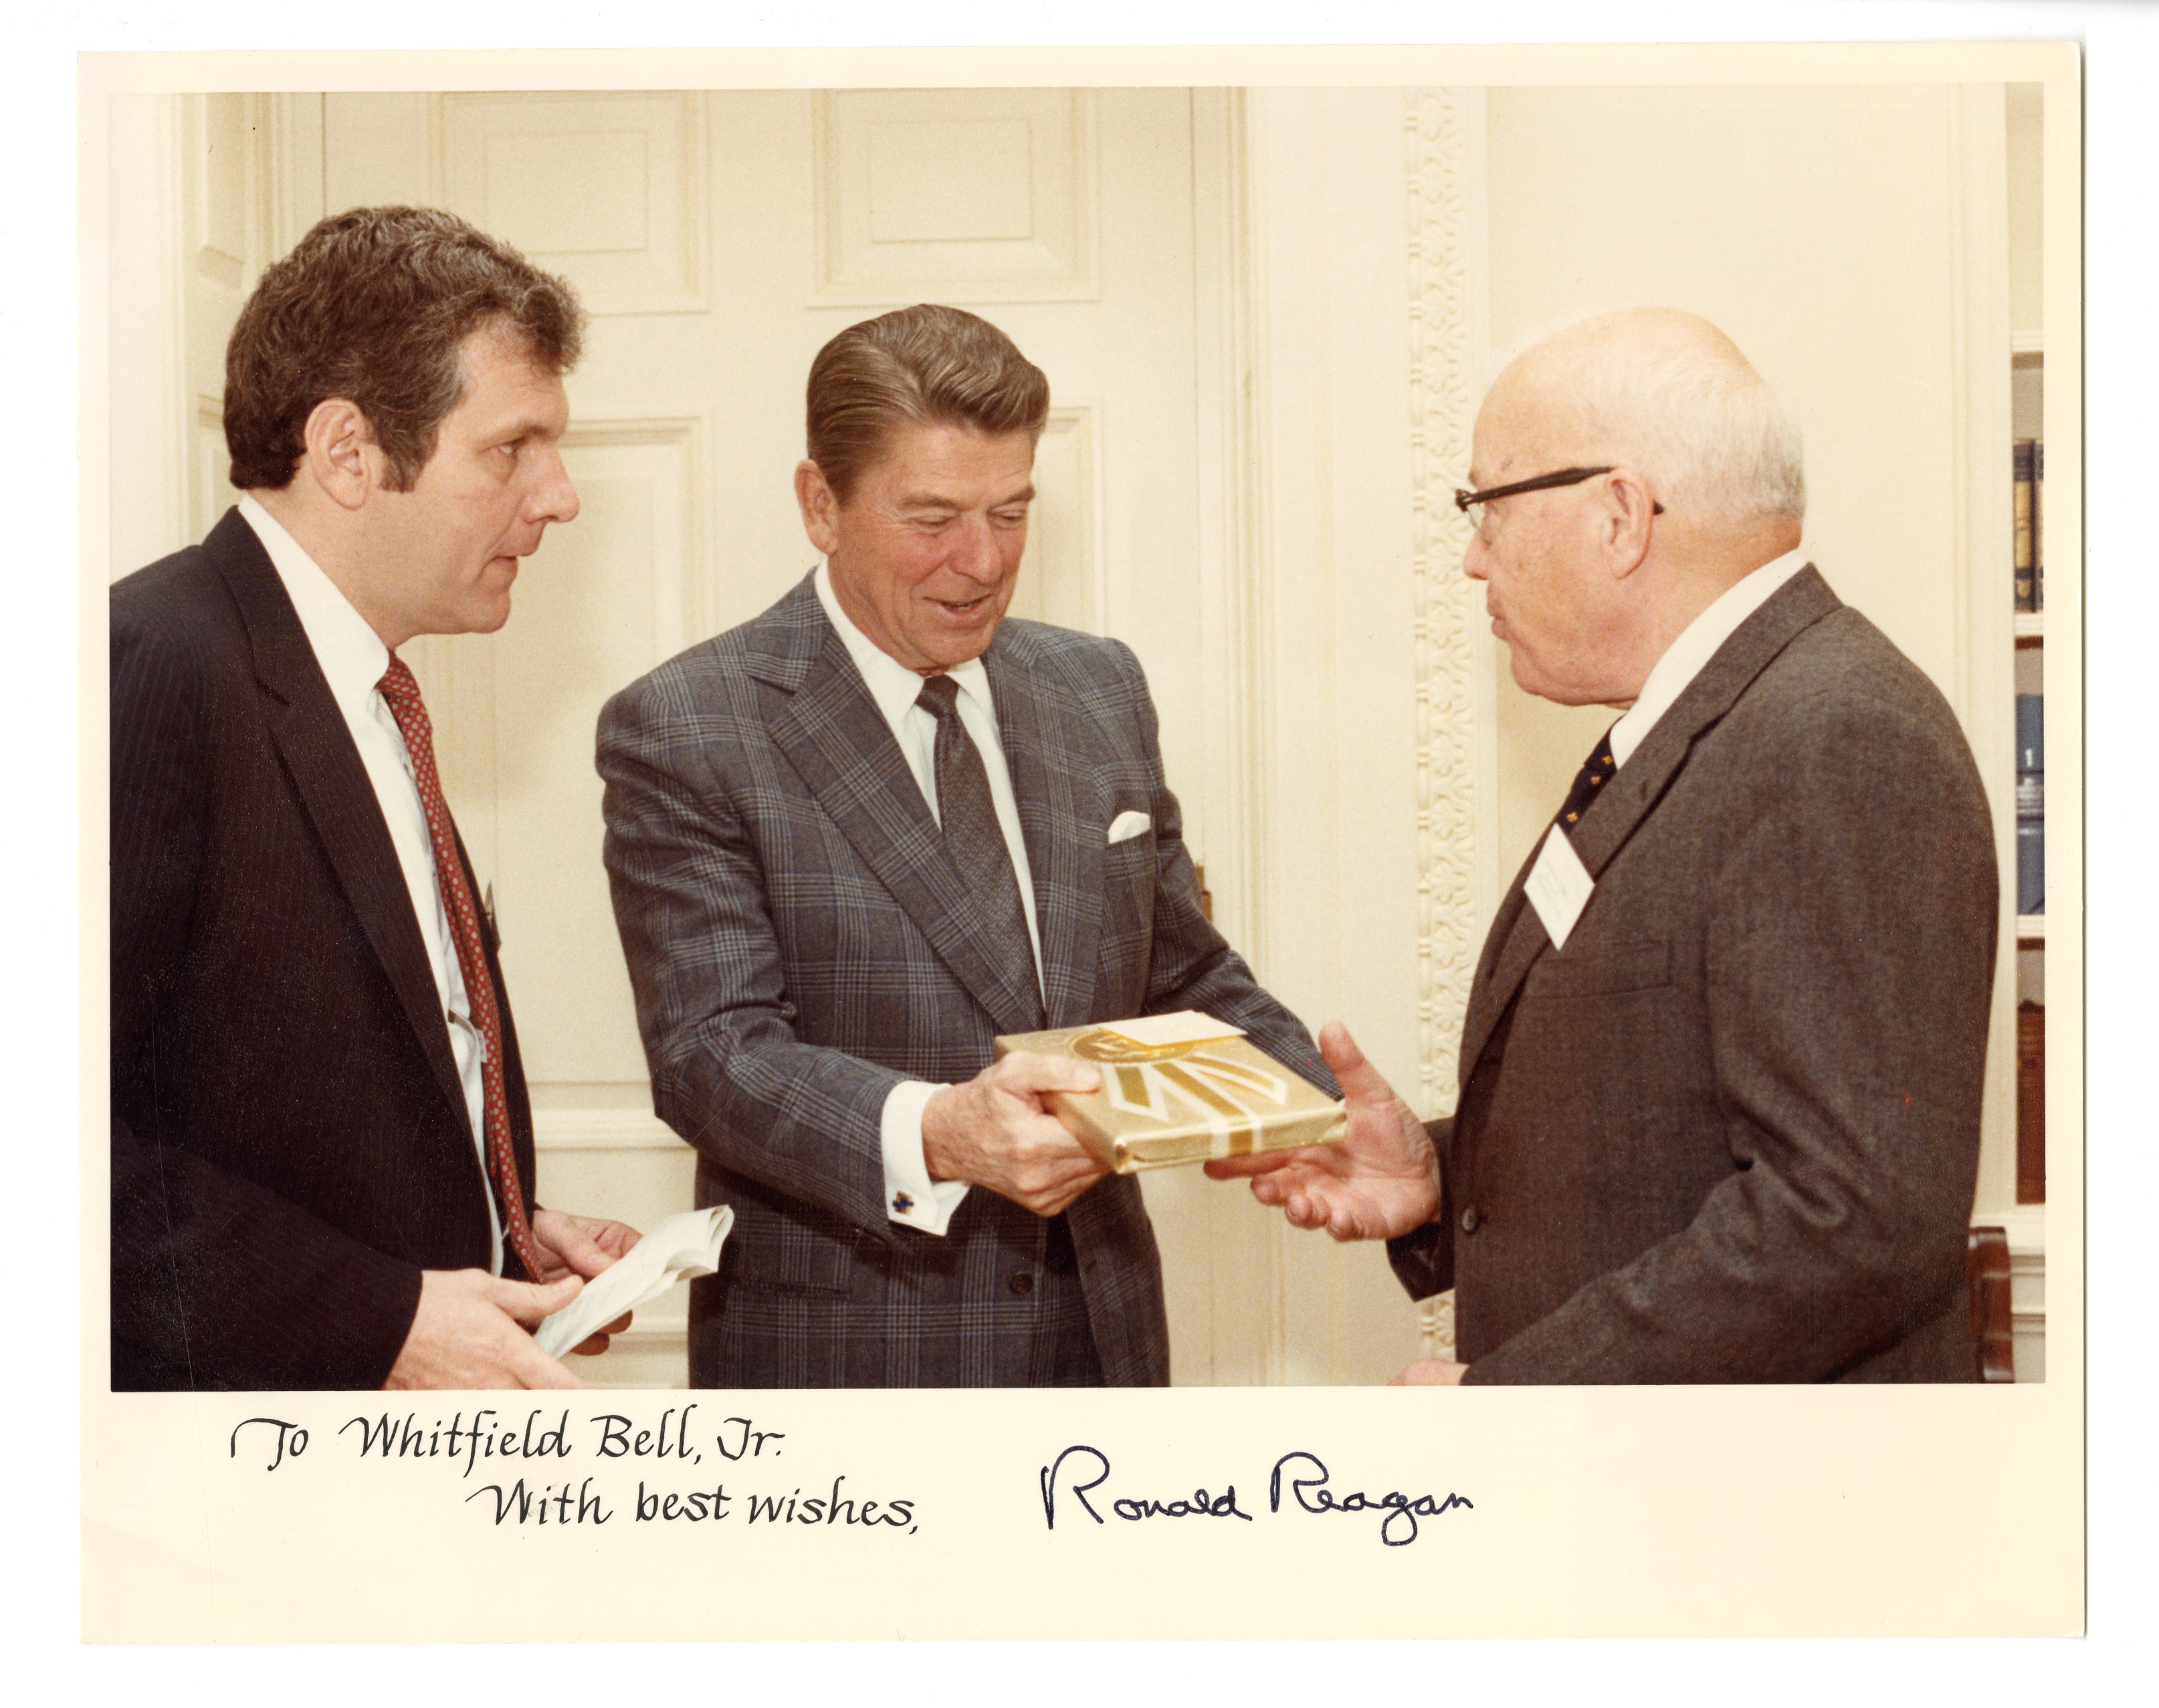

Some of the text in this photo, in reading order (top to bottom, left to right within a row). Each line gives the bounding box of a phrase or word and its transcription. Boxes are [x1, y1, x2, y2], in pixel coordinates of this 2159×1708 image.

[230, 1404, 786, 1479] To Whitfield Bell, Jr.
[464, 1475, 918, 1535] With best wishes,
[1040, 1445, 1474, 1547] Ronald Reagan
